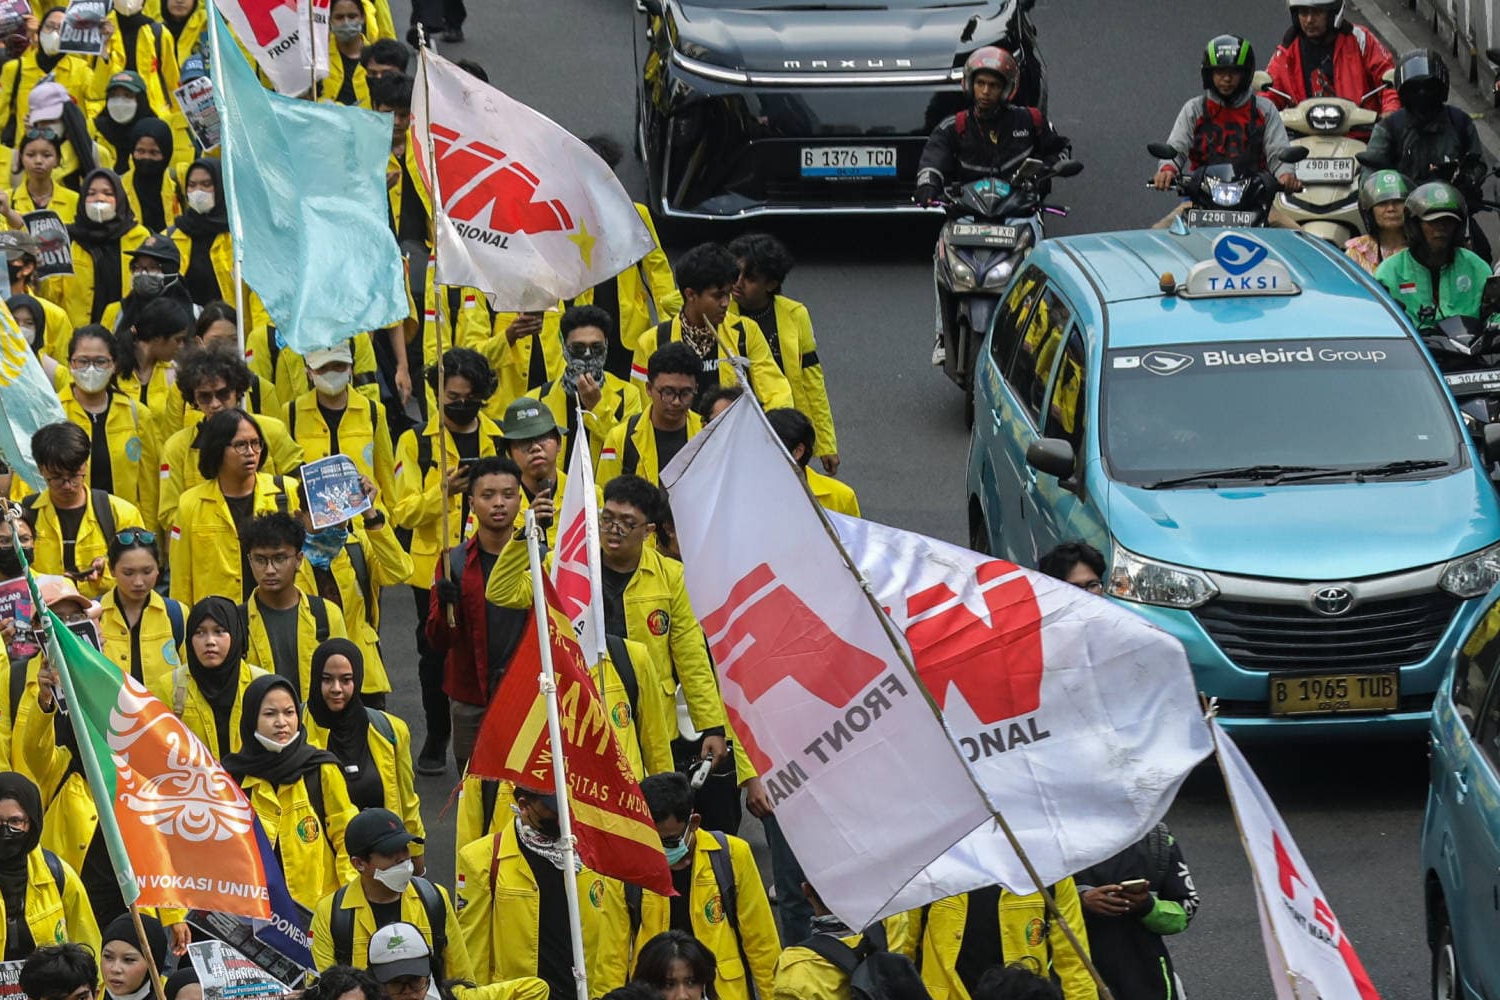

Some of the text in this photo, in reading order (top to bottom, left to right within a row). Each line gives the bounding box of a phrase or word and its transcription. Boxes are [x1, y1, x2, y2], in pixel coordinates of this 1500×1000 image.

[783, 58, 912, 69] MAXUS
[804, 151, 814, 167] B
[821, 150, 858, 167] 1376
[451, 221, 509, 250] SIONAL
[1208, 277, 1278, 291] TAKSI
[1203, 347, 1387, 367] Bluebird Group
[1276, 676, 1393, 702] B 1965 TUB
[150, 874, 213, 892] VOKASI
